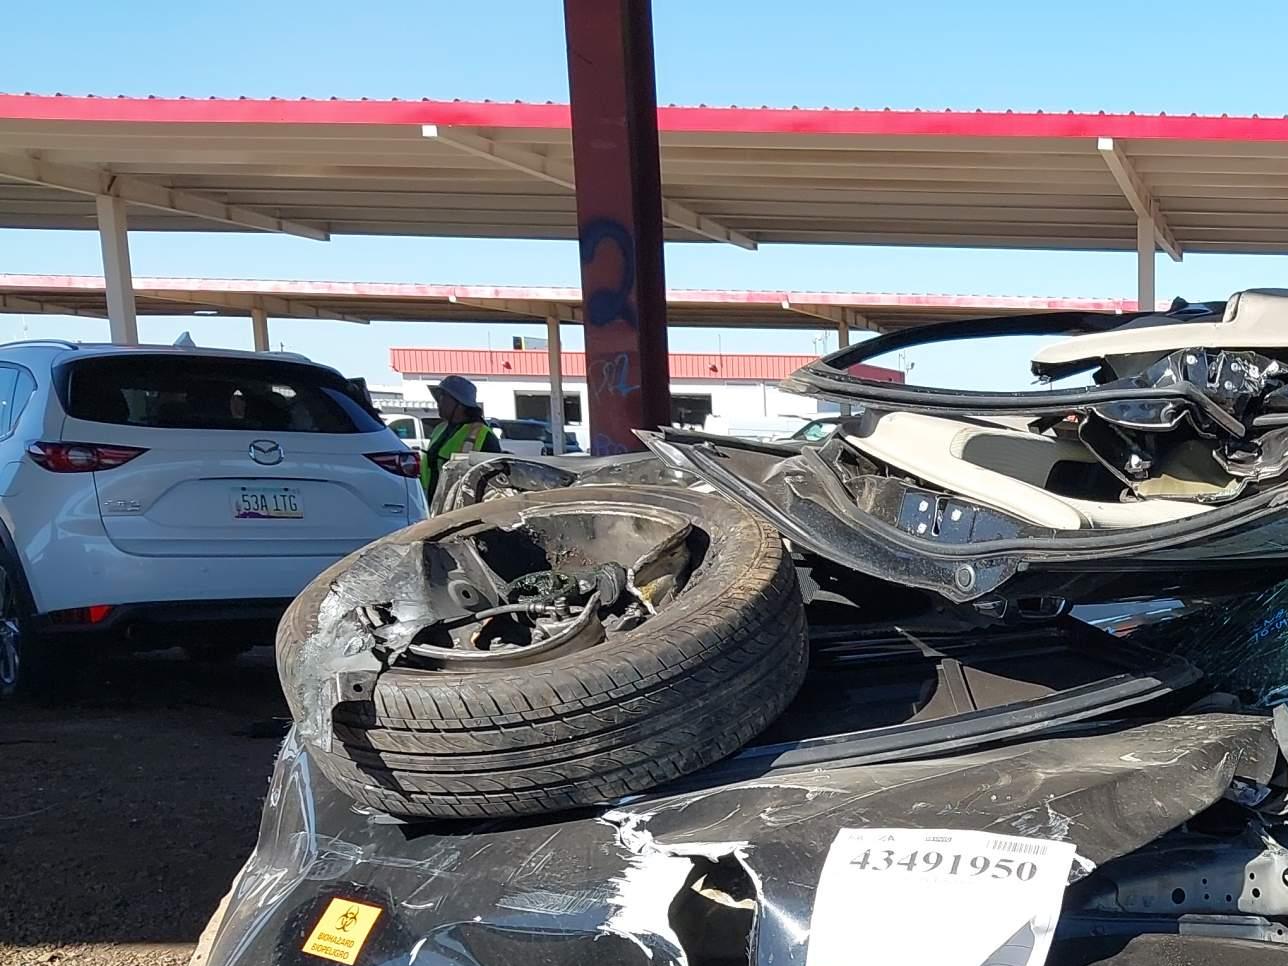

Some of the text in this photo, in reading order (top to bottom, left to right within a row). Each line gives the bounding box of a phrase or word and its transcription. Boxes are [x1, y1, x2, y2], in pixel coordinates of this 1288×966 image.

[241, 494, 298, 512] 53A 1TG
[848, 848, 1037, 882] 43491950
[317, 931, 355, 949] BIOHAZARD
[310, 943, 350, 960] BIOPELIGRO
